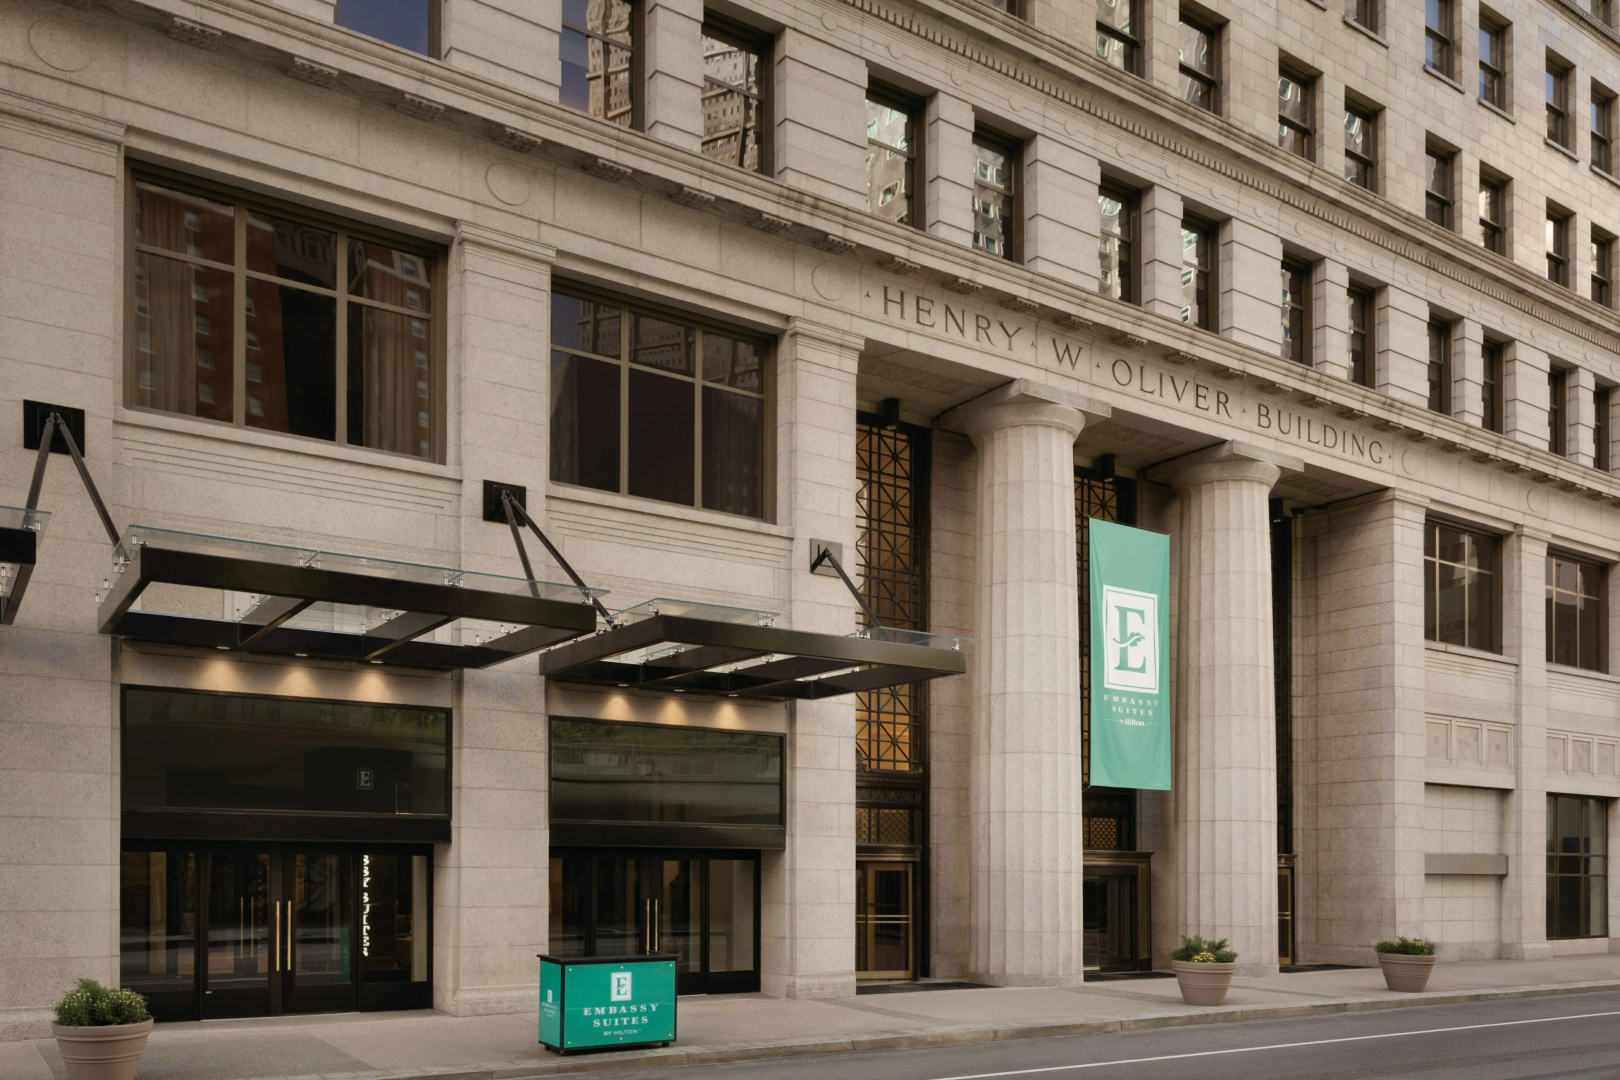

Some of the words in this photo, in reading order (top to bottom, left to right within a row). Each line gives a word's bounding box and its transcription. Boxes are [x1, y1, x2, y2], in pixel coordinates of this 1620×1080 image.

[883, 285, 1023, 351] HENRY
[1050, 336, 1083, 370] W
[1111, 359, 1232, 419] OLIVER
[1257, 403, 1383, 464] BUILDING
[1103, 694, 1158, 707] EMBASSY
[1112, 705, 1153, 717] SUITES
[1125, 718, 1145, 727] Hilton
[583, 1003, 659, 1016] EMBASSY
[593, 1016, 649, 1028] SUITES
[613, 1028, 638, 1036] HILTON
